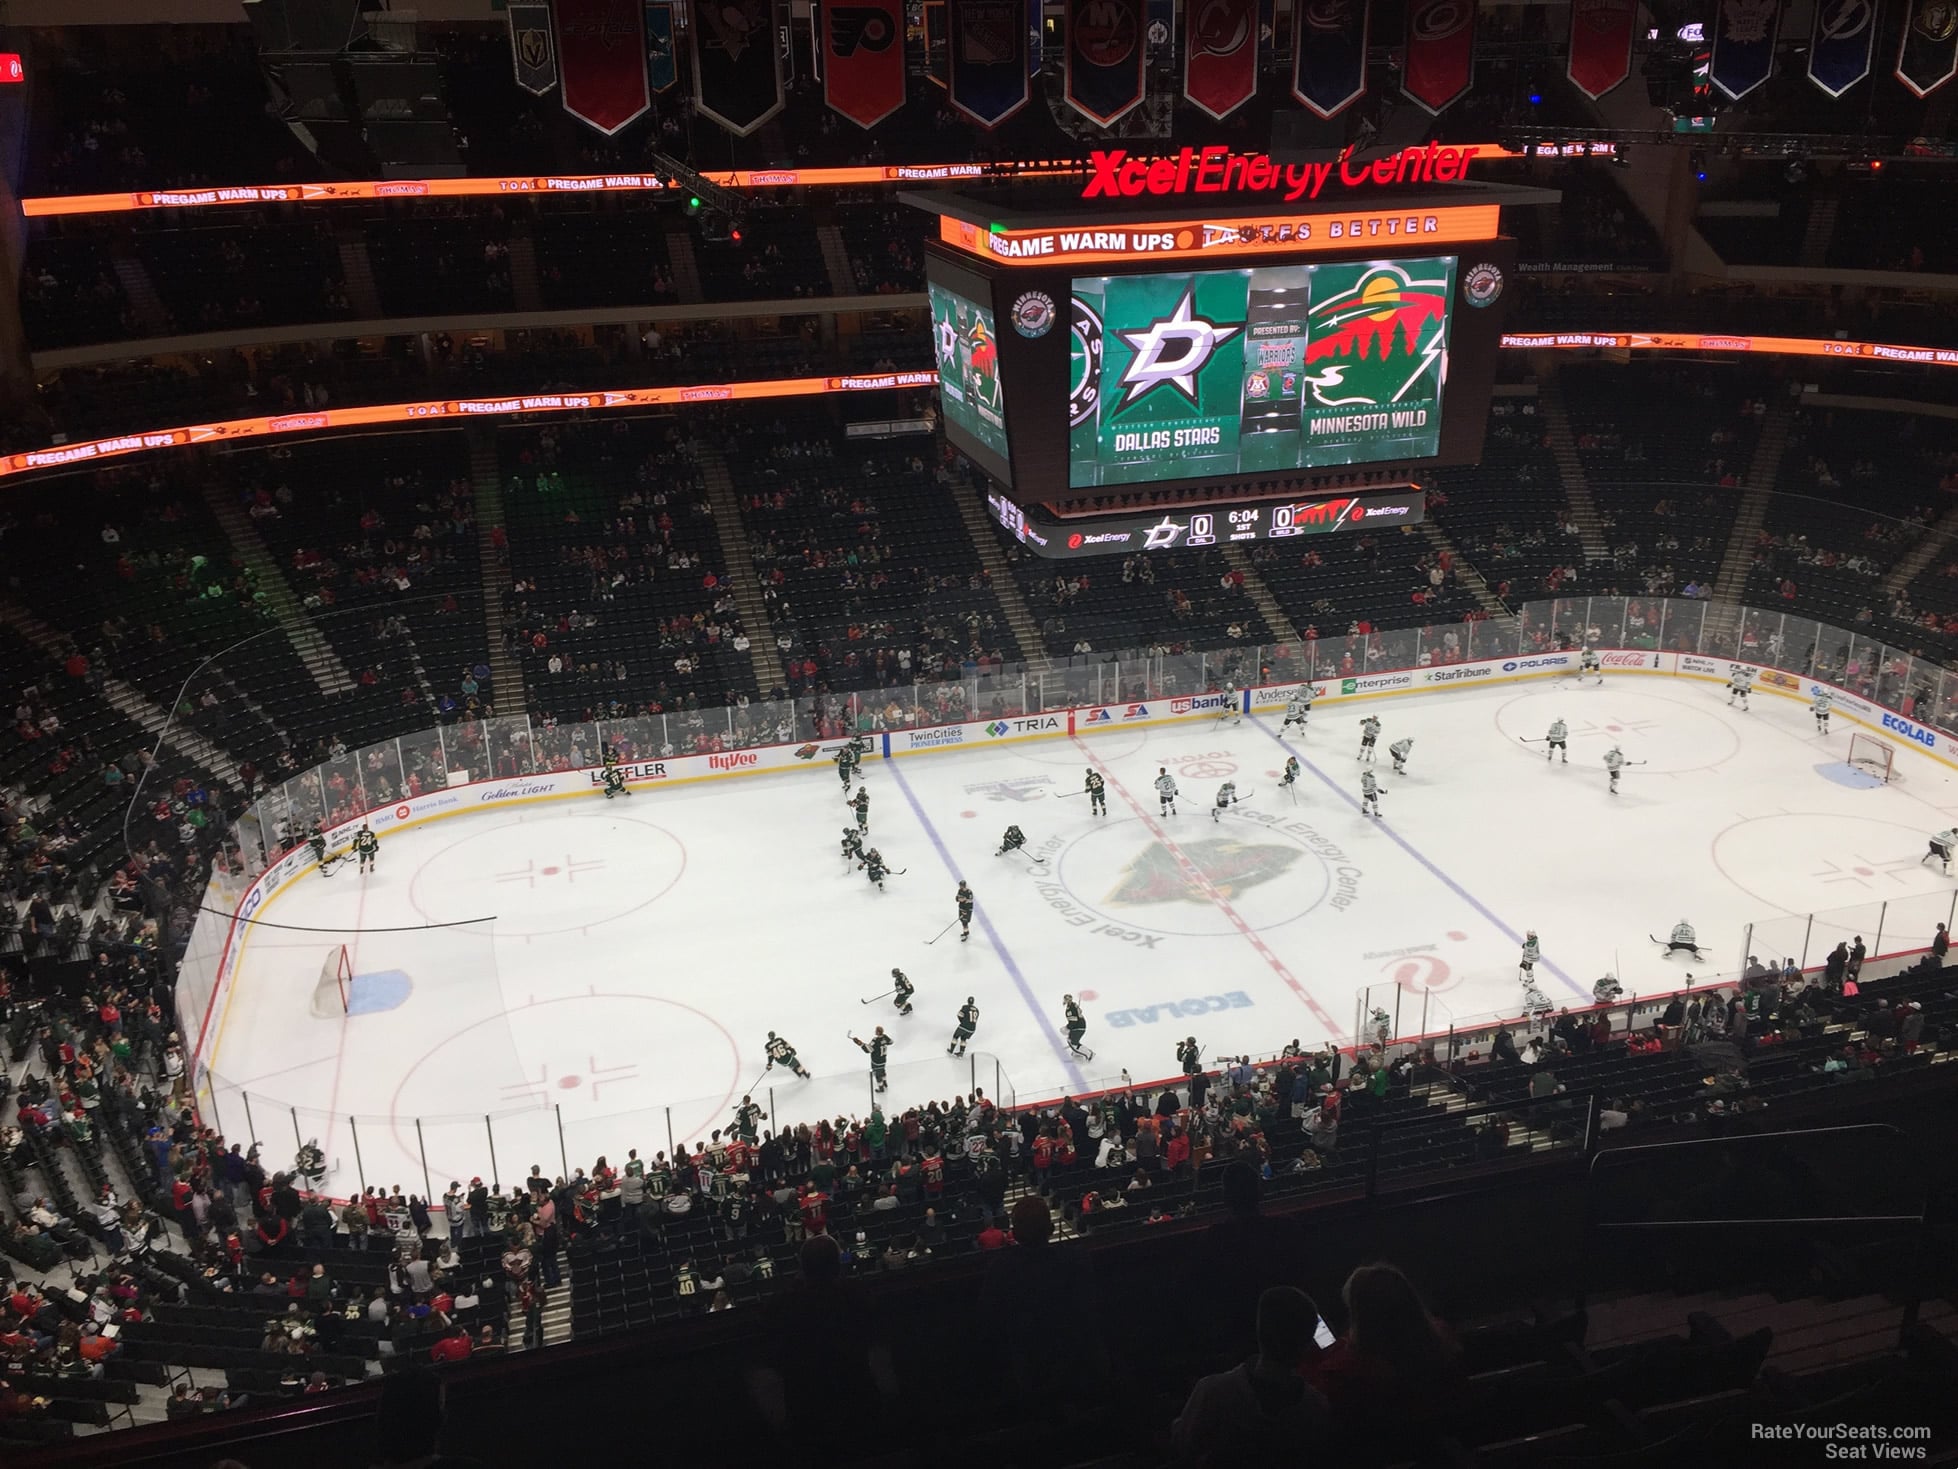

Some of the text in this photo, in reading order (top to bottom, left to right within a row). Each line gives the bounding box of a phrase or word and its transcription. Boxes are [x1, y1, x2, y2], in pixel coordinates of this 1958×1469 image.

[898, 166, 982, 178] PREGAME WARM
[547, 179, 605, 191] PREGAME
[606, 177, 640, 188] WARM
[153, 185, 288, 206] PREGAME WARM UPS
[1329, 216, 1439, 239] BETTER
[989, 231, 1055, 258] PREGAME
[1060, 232, 1127, 253] WARM
[1132, 230, 1175, 252] UPS
[1501, 334, 1616, 348] PREGAME WARM UPS
[1873, 348, 1935, 361] PREGAME
[842, 377, 896, 391] PREGAME
[897, 375, 929, 386] WARM
[459, 400, 523, 413] PREGAME
[523, 397, 563, 409] WARM
[564, 395, 590, 407] UPS
[1310, 409, 1427, 435] MINNESOTA WILD
[1115, 426, 1220, 452] DALLAS STARS
[27, 432, 174, 466] PREGAME WARM UPS
[1194, 517, 1209, 535] 0
[1228, 510, 1259, 524] 6:04
[1276, 509, 1290, 527] 0
[1229, 532, 1256, 541] SHOTS
[1520, 657, 1568, 669] POLARIS
[1013, 719, 1060, 737] TRIA
[1882, 713, 1936, 747] ECOLAB
[482, 789, 519, 801] Golden
[521, 784, 556, 795] LIGHT
[1104, 989, 1255, 1029] ECOLAB
